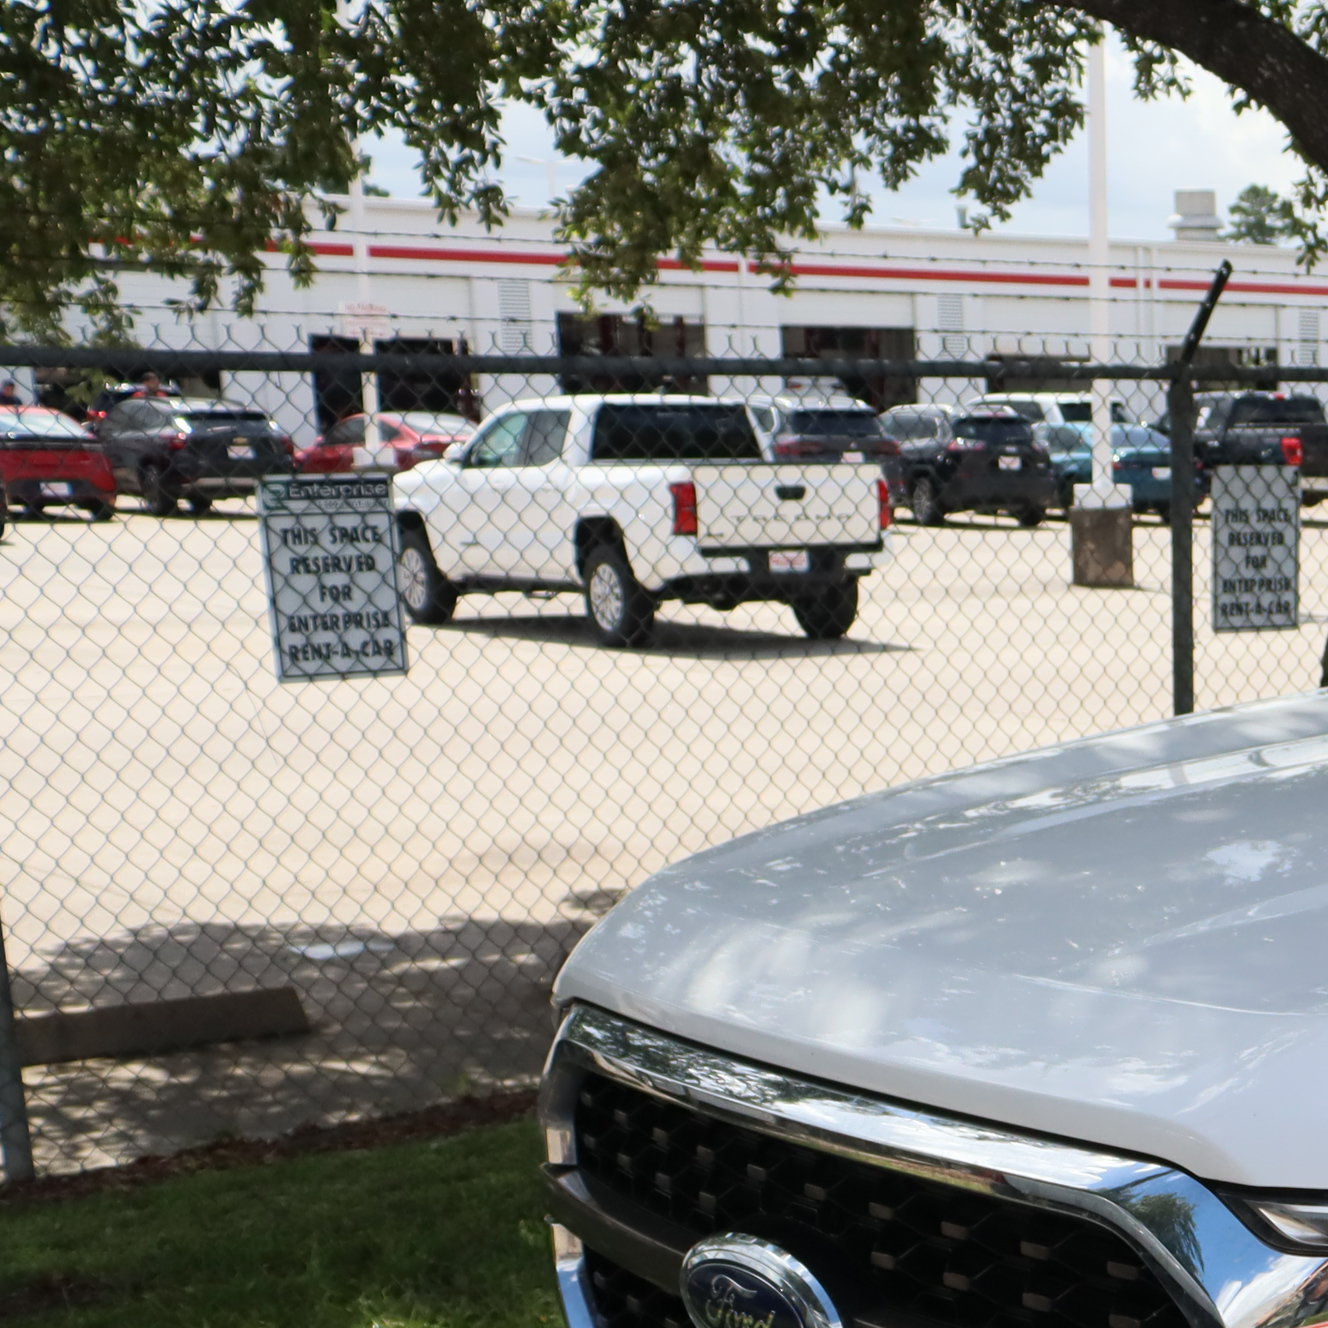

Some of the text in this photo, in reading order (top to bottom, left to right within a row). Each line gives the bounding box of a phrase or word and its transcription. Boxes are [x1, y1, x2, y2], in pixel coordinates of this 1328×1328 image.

[289, 482, 387, 498] Enterprise
[281, 525, 381, 546] THIS SPACE
[290, 554, 376, 575] RESERVED
[319, 583, 352, 603] FOR
[288, 611, 390, 633] ENTERPRISE
[288, 639, 394, 662] RENT-A-CAR
